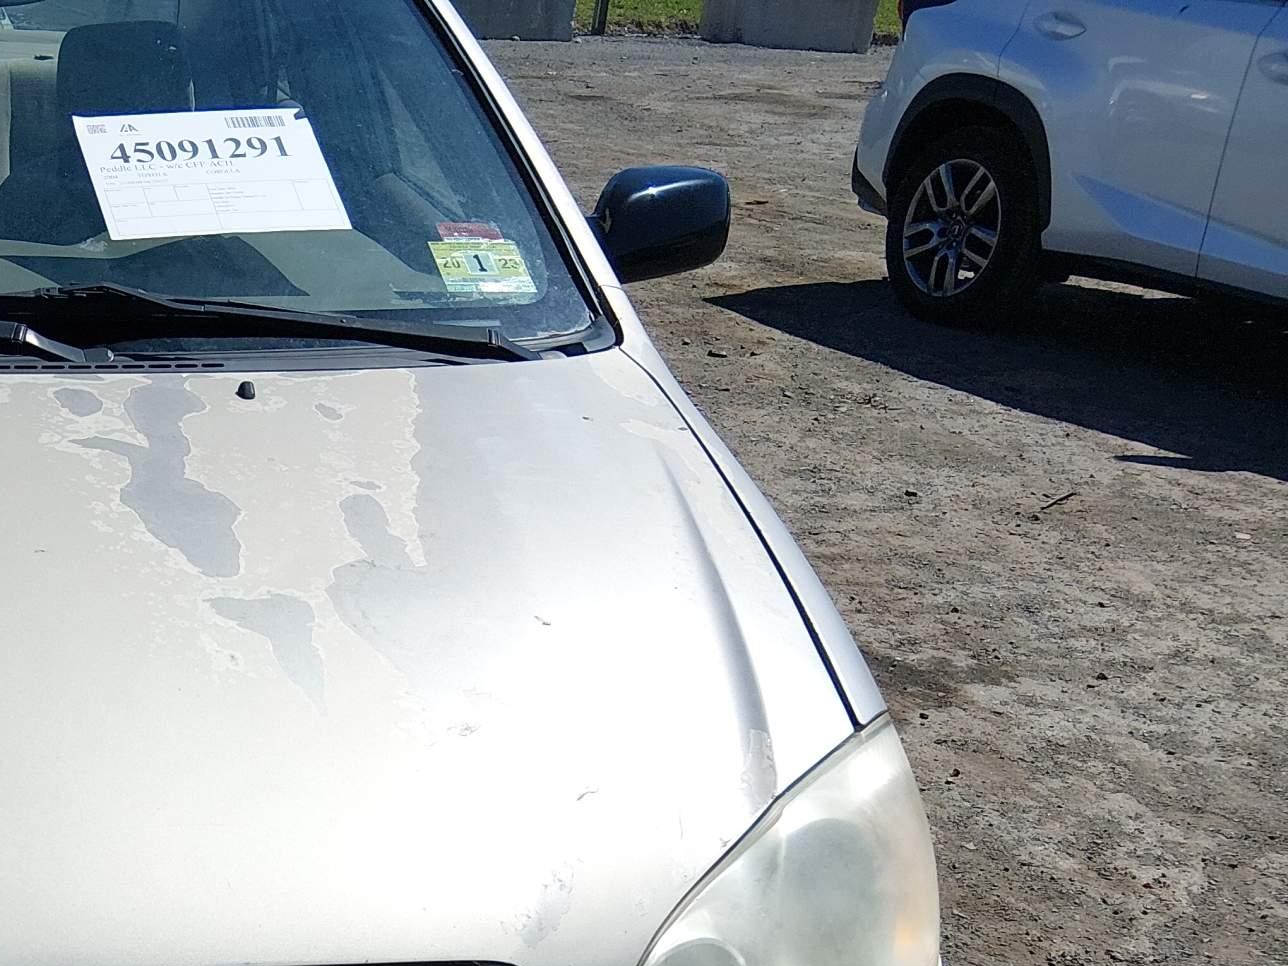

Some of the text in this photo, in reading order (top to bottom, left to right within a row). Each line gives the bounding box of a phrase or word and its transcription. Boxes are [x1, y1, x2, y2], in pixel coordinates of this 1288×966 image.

[110, 135, 293, 164] 45091291
[100, 164, 132, 174] Peddle
[442, 257, 461, 269] 20
[472, 254, 488, 272] 1
